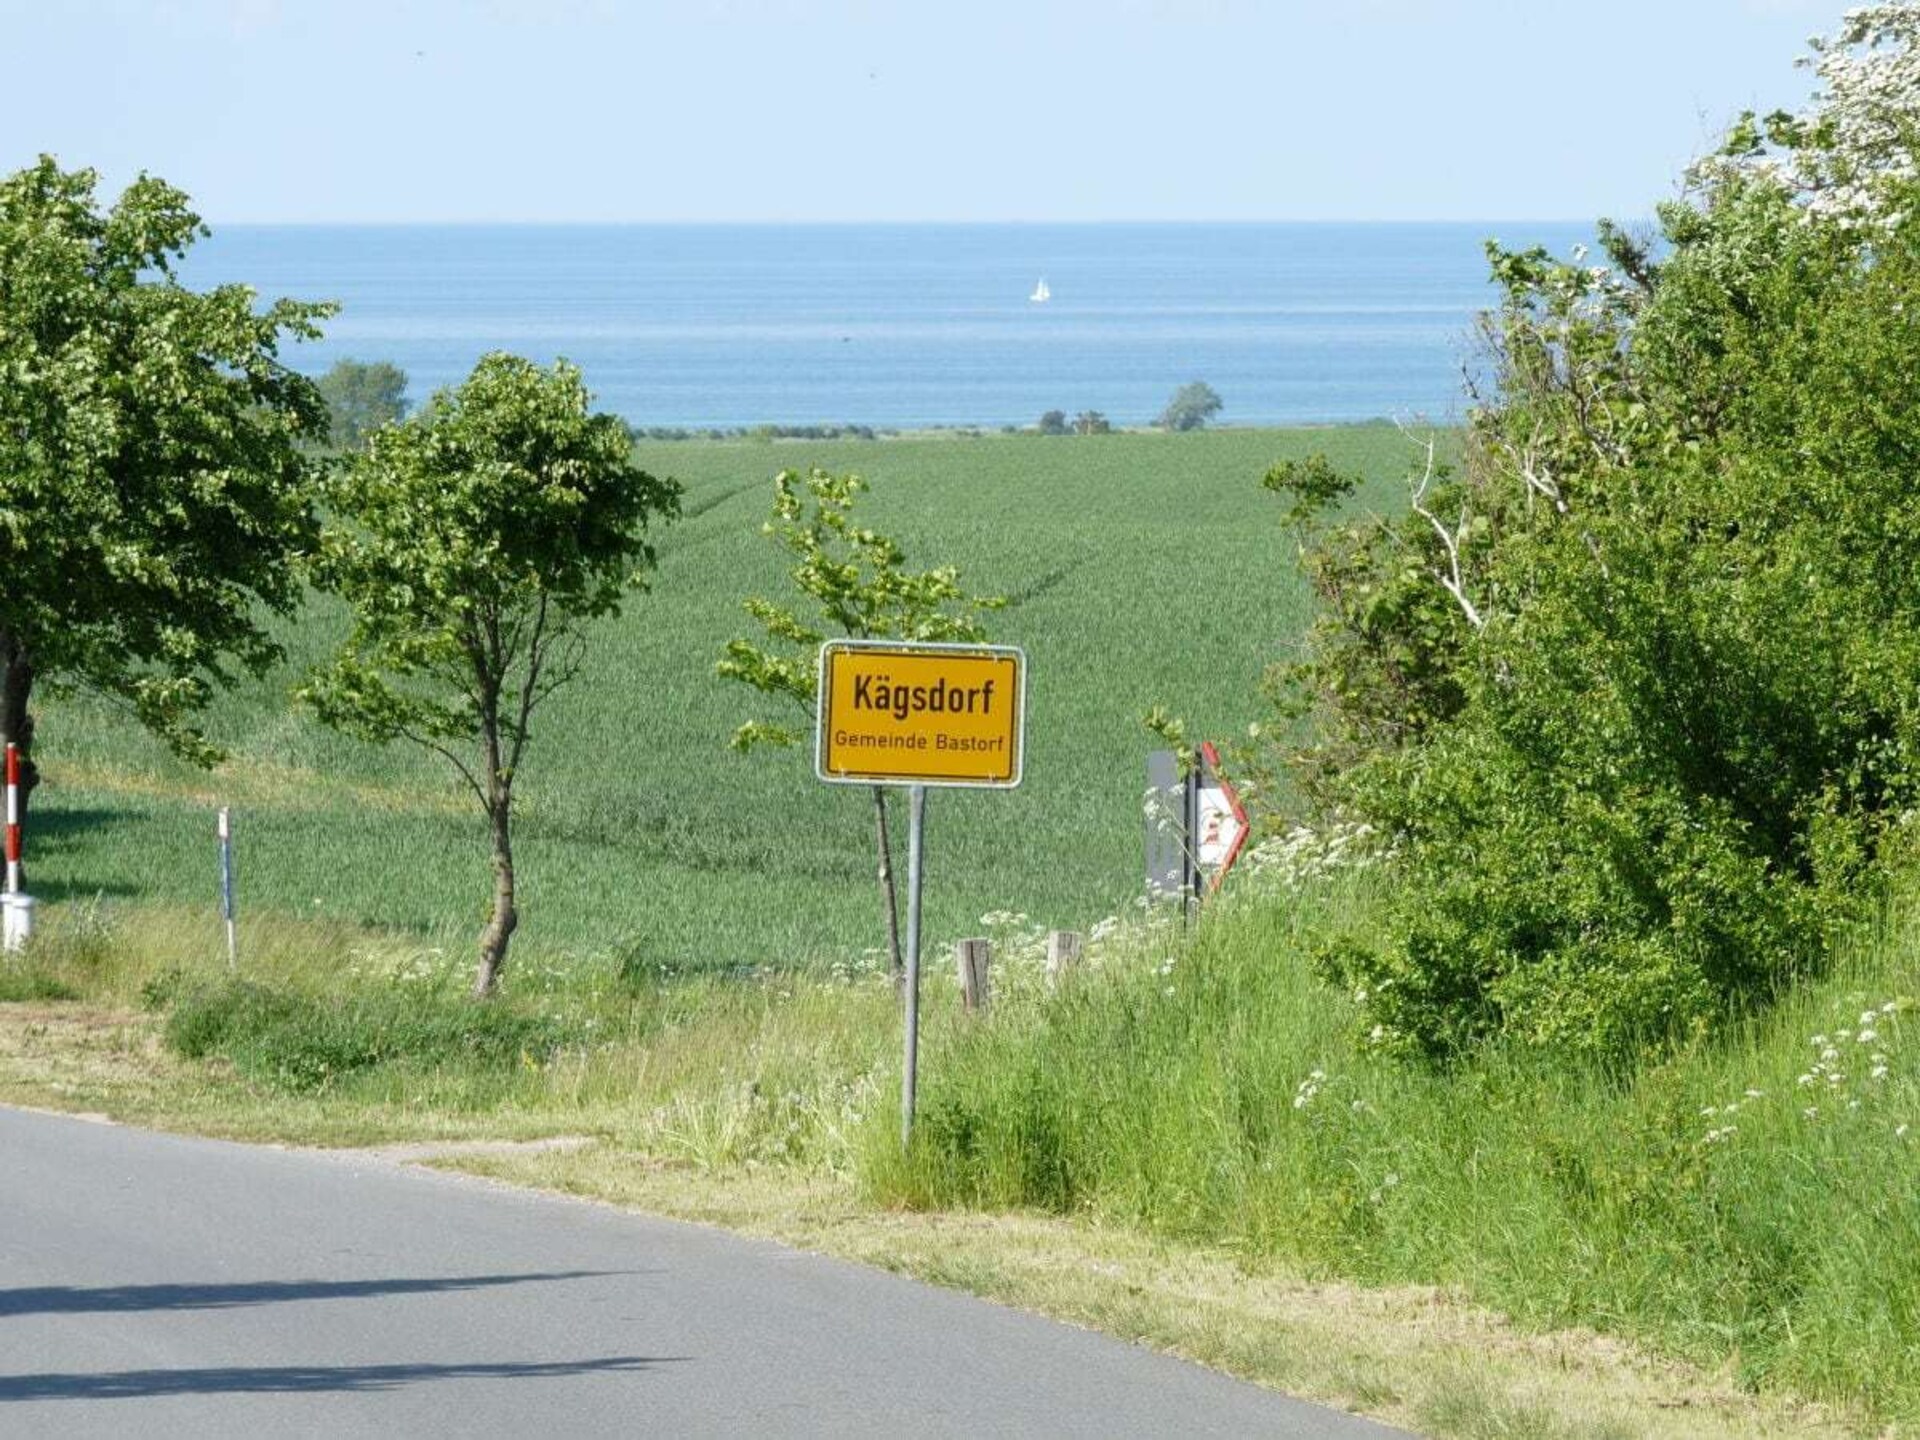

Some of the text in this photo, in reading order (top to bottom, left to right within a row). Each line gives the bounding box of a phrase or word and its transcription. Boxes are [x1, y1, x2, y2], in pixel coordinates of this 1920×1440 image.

[854, 674, 994, 719] Kägsdorf
[835, 730, 1004, 752] Gemeinde Bastorf
